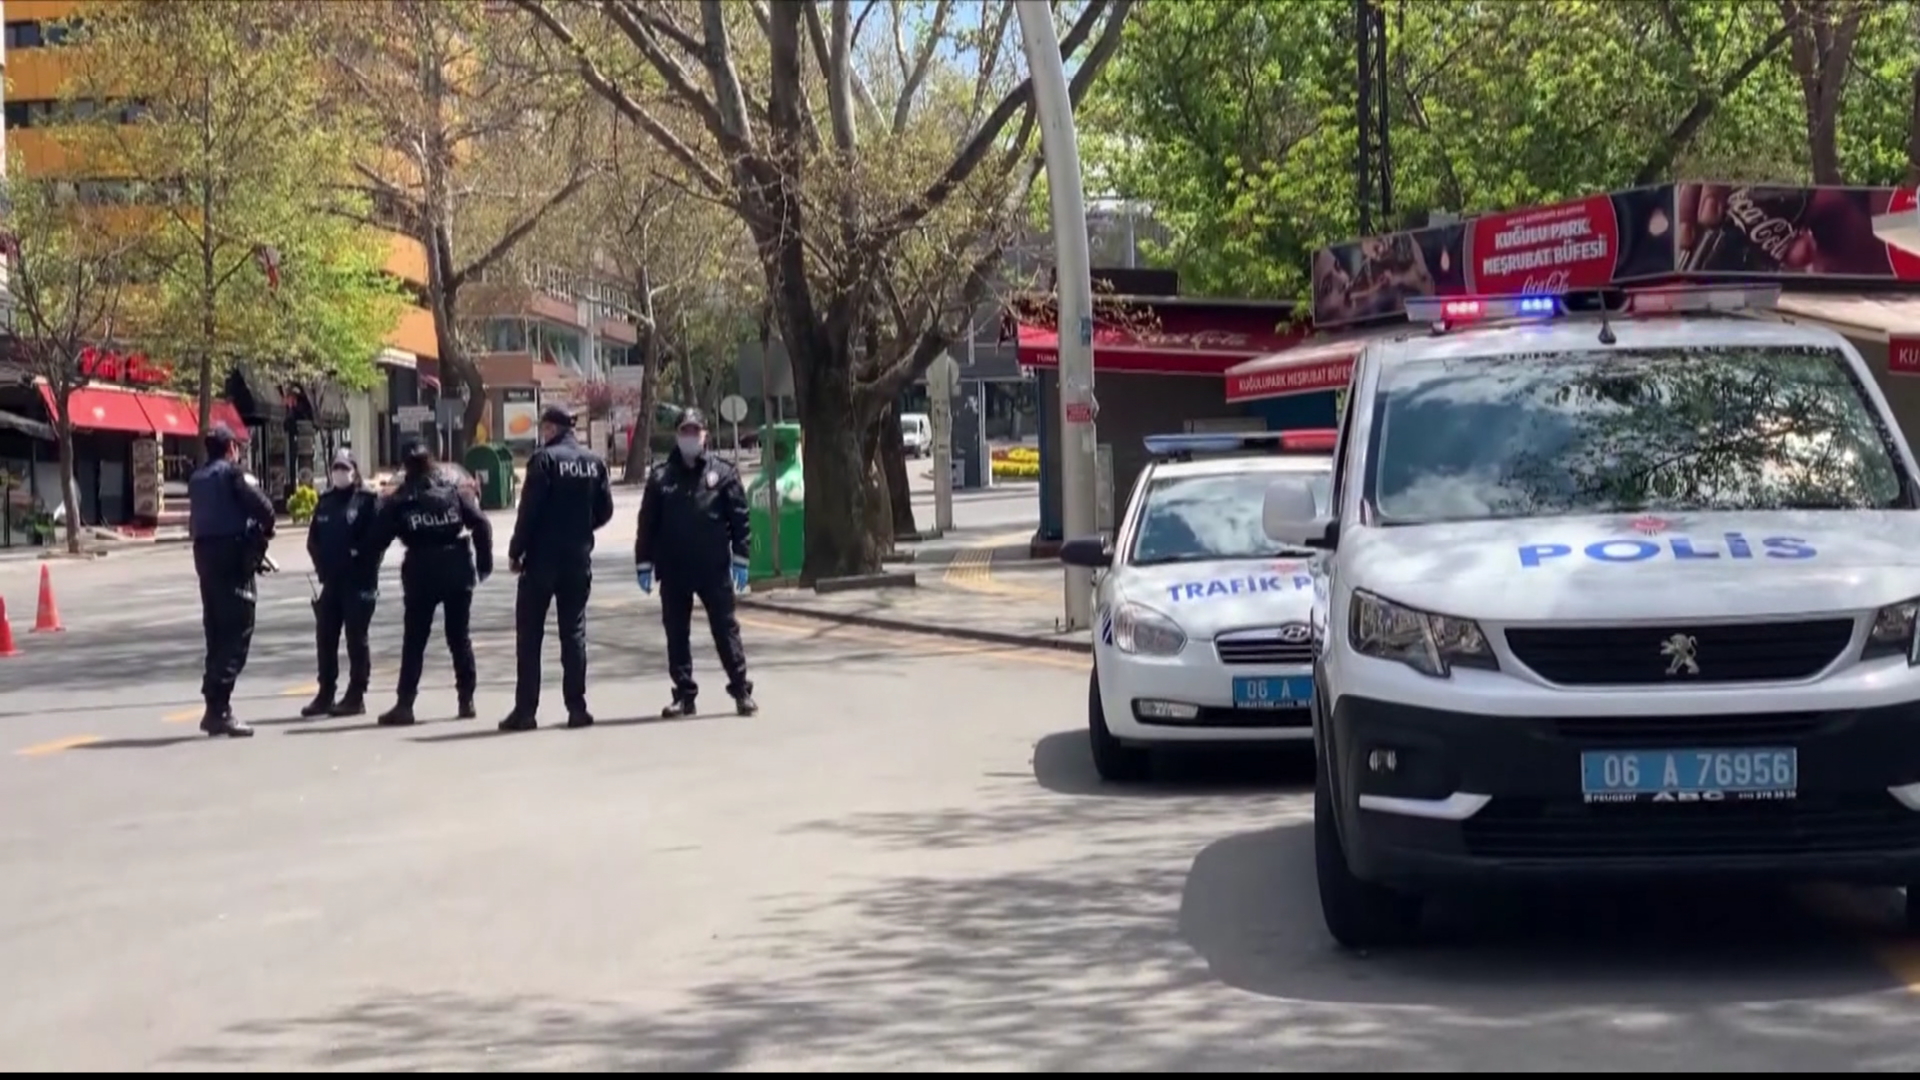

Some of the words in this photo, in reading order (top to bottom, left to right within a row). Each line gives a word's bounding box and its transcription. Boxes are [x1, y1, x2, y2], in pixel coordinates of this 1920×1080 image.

[1495, 225, 1549, 250] KUĞULU
[1483, 247, 1553, 276] MEŞRUBAT
[1554, 234, 1608, 264] BÜFESİ
[1518, 532, 1817, 567] POLİS
[1168, 576, 1281, 601] TRAFİK
[1247, 681, 1267, 698] 06
[1281, 680, 1291, 698] A
[1604, 755, 1639, 787] 06
[1663, 754, 1678, 786] A
[1697, 752, 1790, 785] 76956
